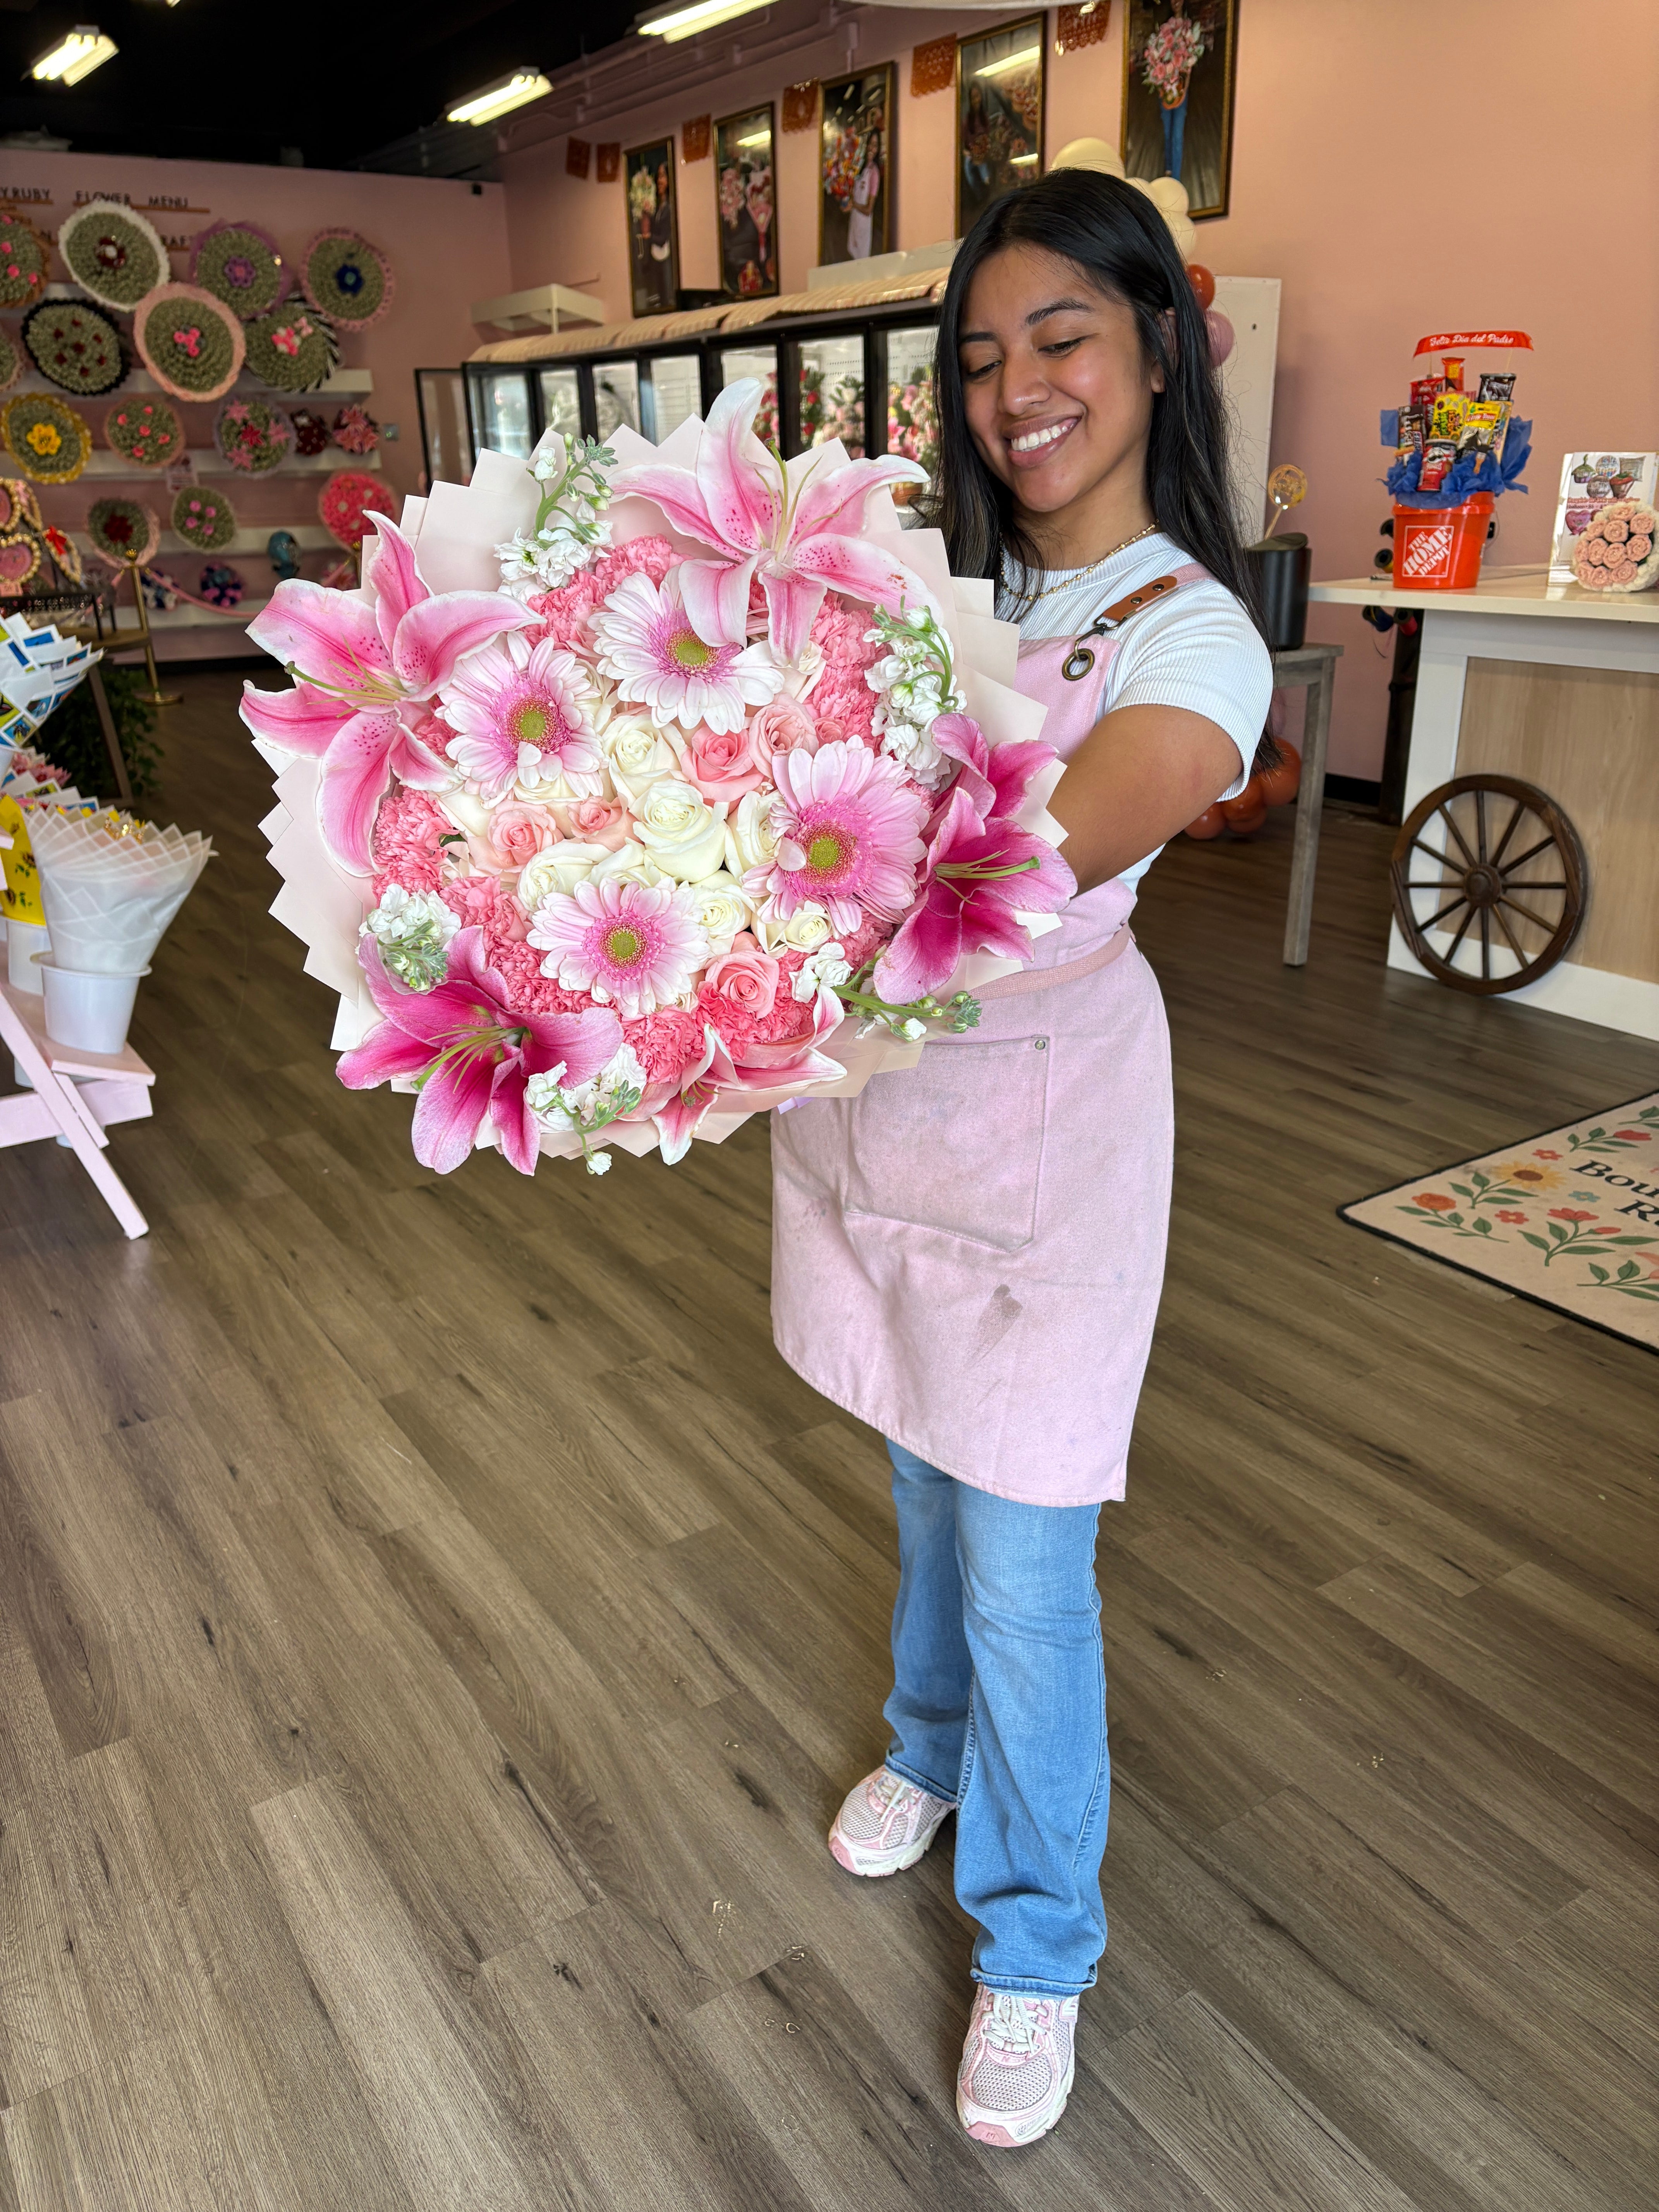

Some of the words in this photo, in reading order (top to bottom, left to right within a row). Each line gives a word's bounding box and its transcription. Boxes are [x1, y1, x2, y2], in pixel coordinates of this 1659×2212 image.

[148, 195, 188, 208] MENU
[1471, 334, 1487, 342] del
[1487, 333, 1514, 344] Padre
[1403, 526, 1452, 576] HOME
[1408, 531, 1428, 551] THE
[1419, 544, 1449, 577] DEPOT
